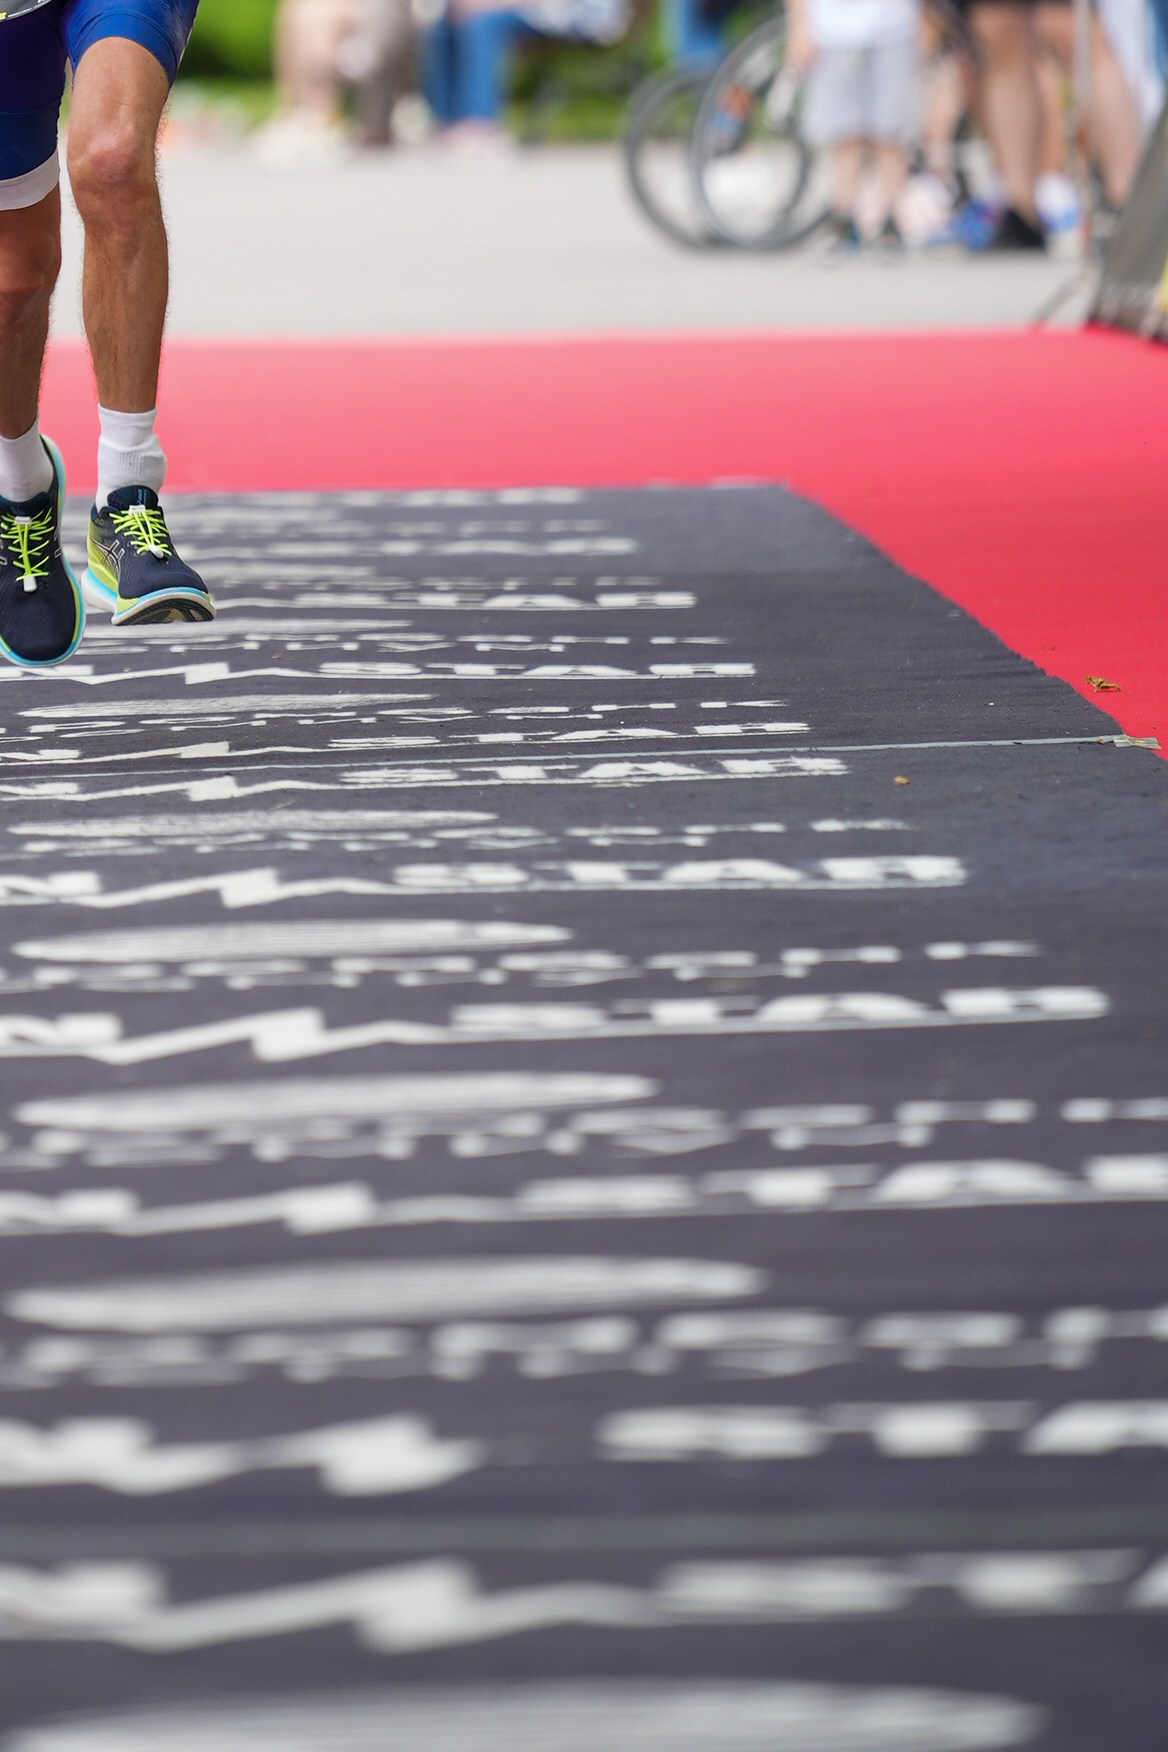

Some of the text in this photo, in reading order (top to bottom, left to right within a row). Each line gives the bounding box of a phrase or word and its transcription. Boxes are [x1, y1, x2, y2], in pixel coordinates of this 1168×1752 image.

[319, 661, 756, 677] STAR
[328, 722, 810, 747] STAR
[339, 757, 847, 783] STAR
[393, 855, 967, 887] STAR
[447, 986, 1108, 1034] STAR
